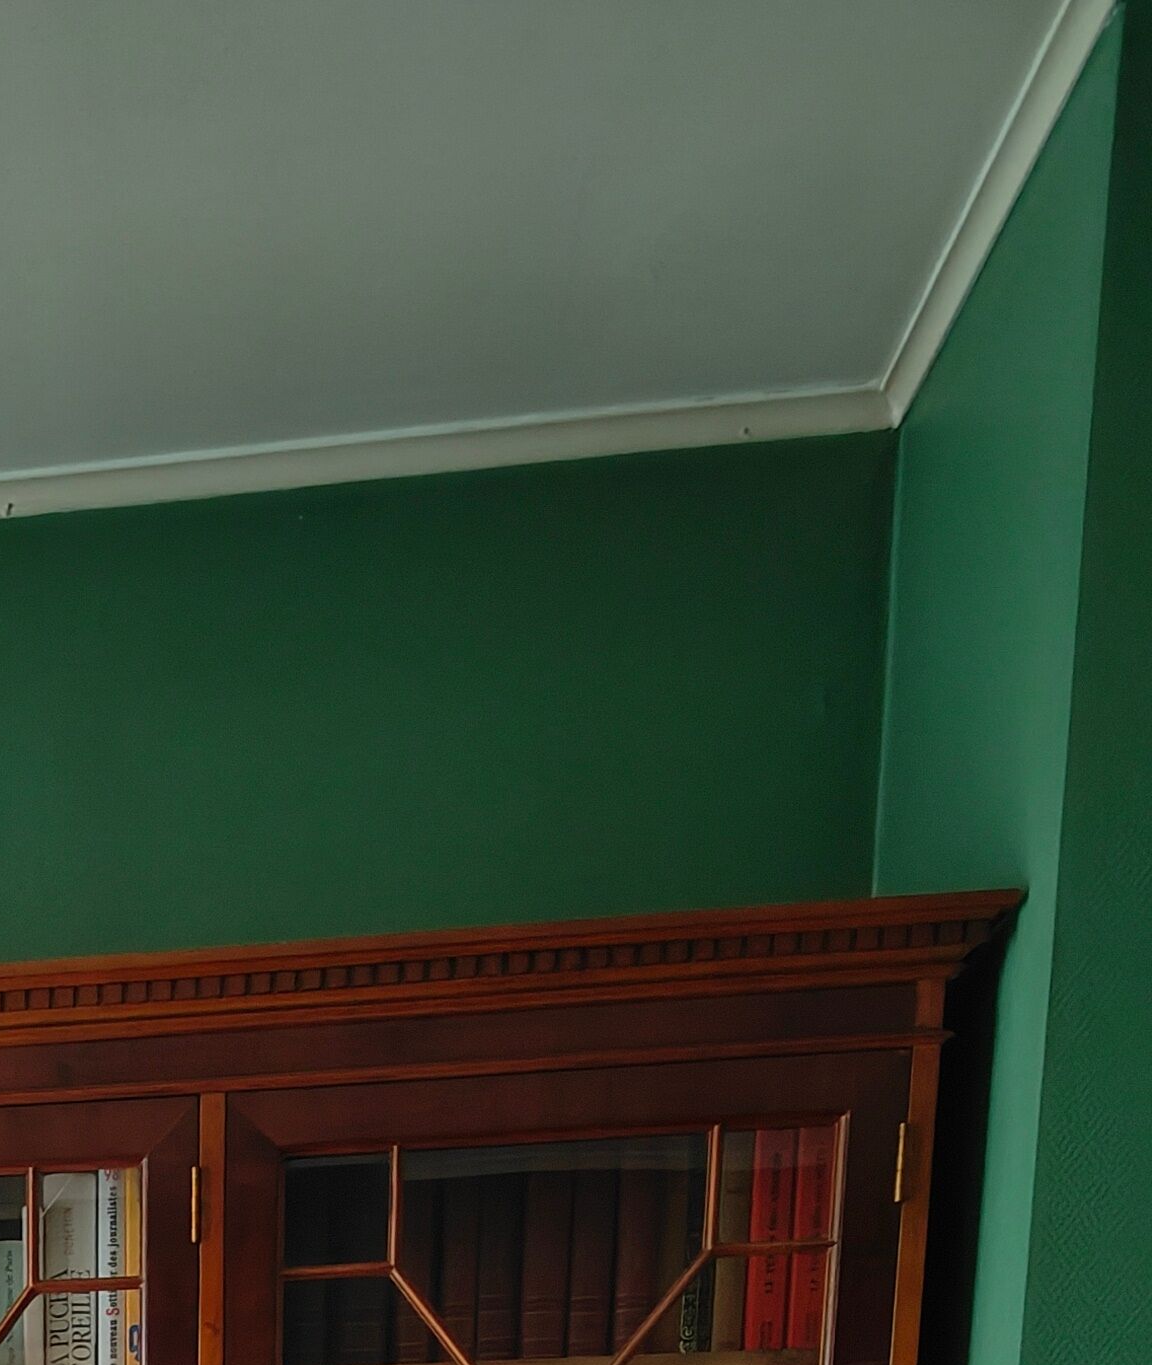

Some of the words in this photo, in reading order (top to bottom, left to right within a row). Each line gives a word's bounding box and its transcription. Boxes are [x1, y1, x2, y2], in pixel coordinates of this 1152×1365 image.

[106, 1186, 120, 1248] journalistes
[107, 1250, 118, 1268] des
[106, 1271, 120, 1317] Sottir
[108, 1320, 118, 1360] nouveau
